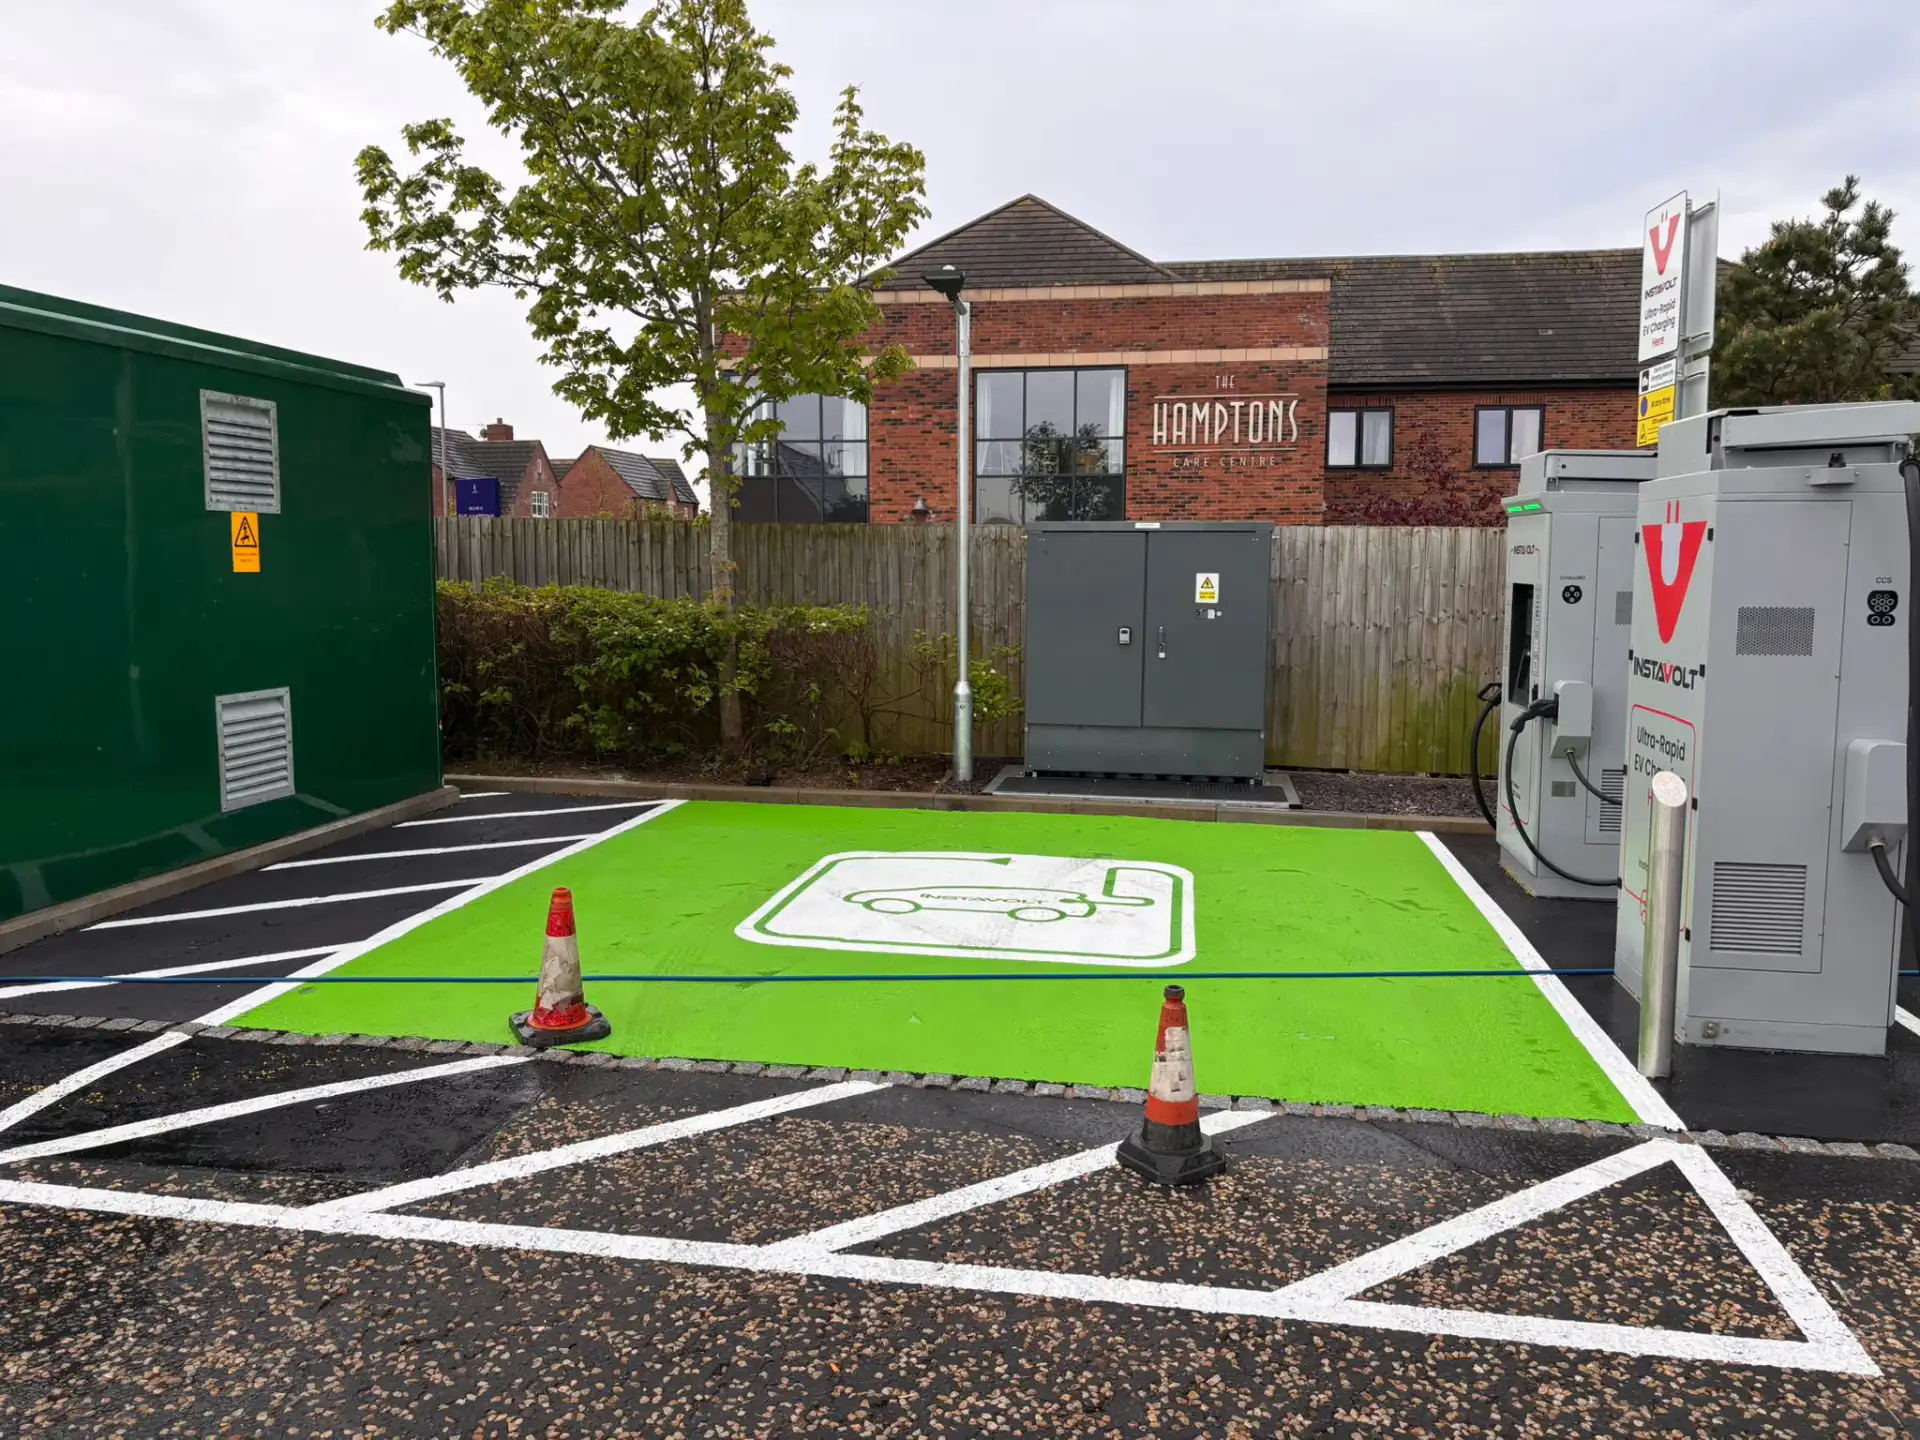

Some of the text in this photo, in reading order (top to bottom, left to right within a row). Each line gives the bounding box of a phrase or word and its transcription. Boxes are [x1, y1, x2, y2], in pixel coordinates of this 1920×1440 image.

[1645, 276, 1677, 300] INSTAVOLT
[1645, 298, 1675, 320] Ultra-Rapid
[1643, 316, 1675, 336] EV Charging
[1215, 375, 1235, 389] THE
[1153, 400, 1299, 445] HAMPTONS
[1173, 456, 1276, 468] CARE CENTRE
[1875, 576, 1892, 584] CCS
[1633, 656, 1698, 690] INSTAVOLT
[1636, 725, 1686, 764] Ultra-Rapid
[1634, 753, 1644, 773] EV
[920, 892, 1050, 904] INSTAVOLT
